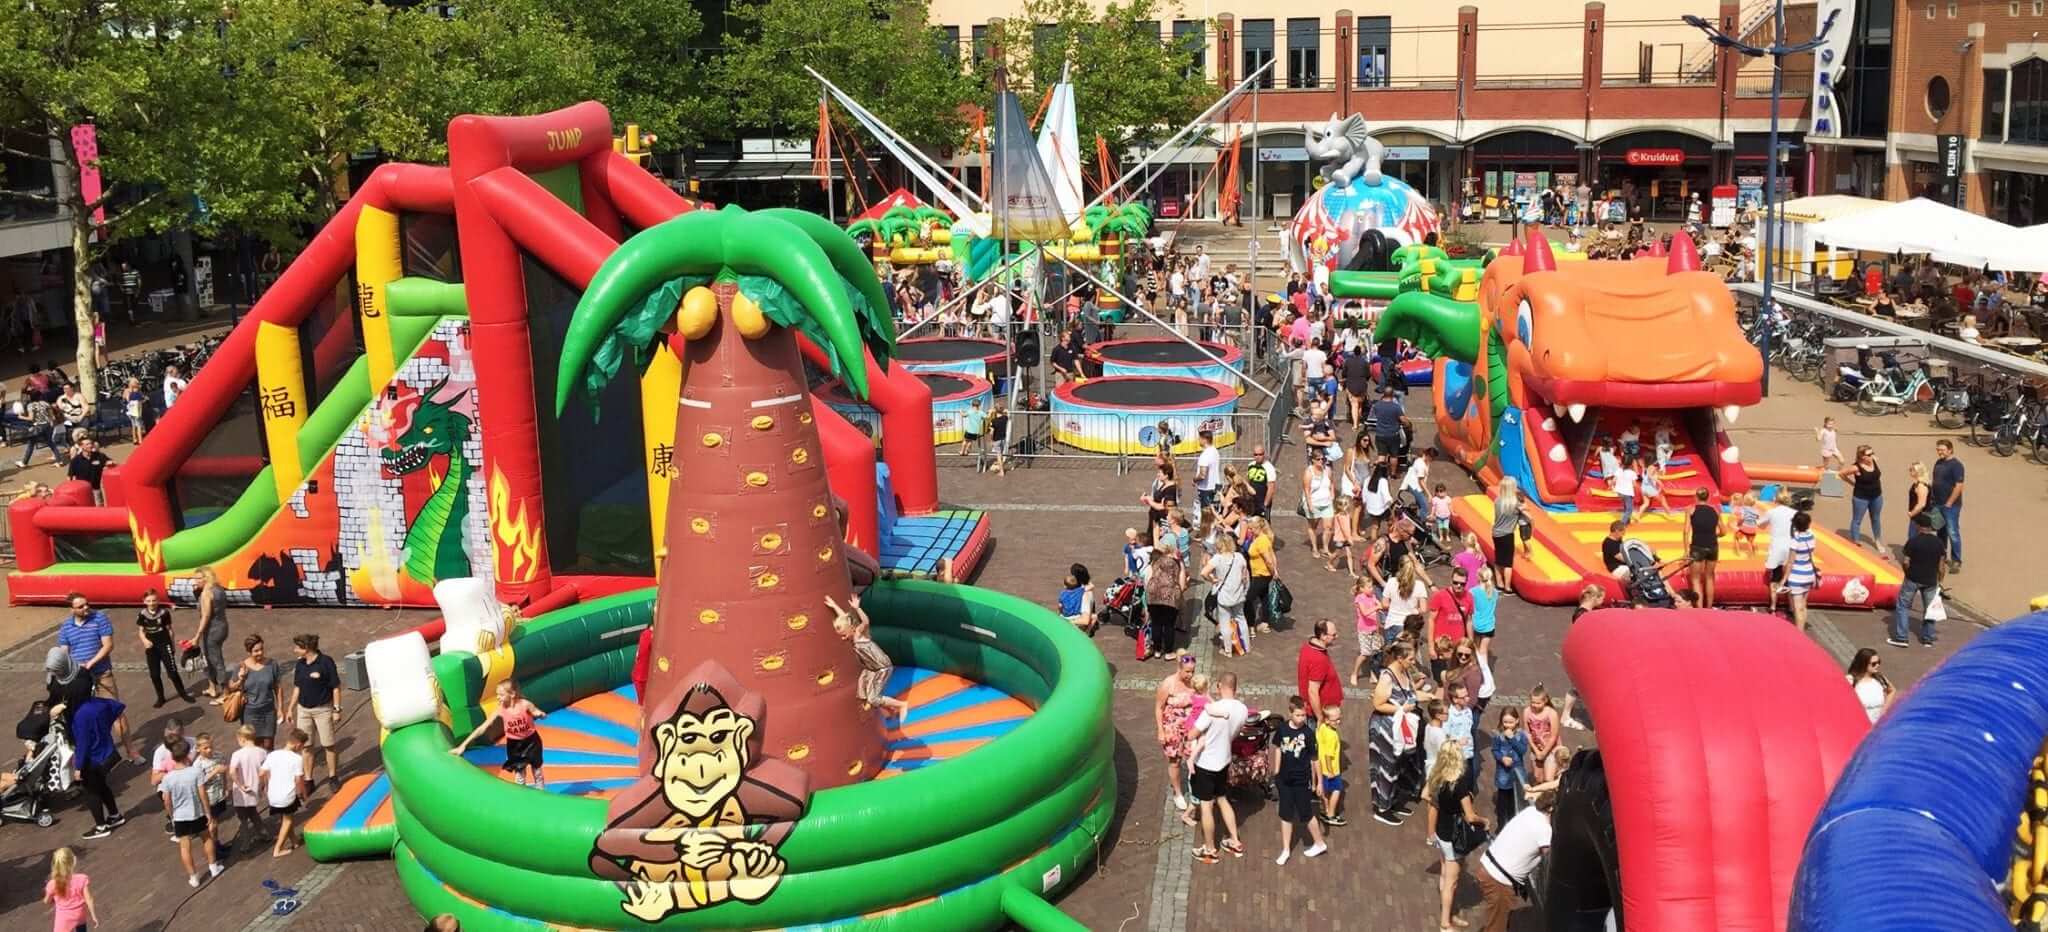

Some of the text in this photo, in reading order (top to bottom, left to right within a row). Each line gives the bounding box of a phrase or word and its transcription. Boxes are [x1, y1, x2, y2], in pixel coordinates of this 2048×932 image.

[546, 127, 582, 152] JUMP
[1640, 152, 1680, 162] Kruidvat
[1947, 135, 1958, 177] PLEIN 10
[260, 386, 295, 421] 福
[651, 443, 674, 478] 康
[507, 717, 526, 727] GIRL
